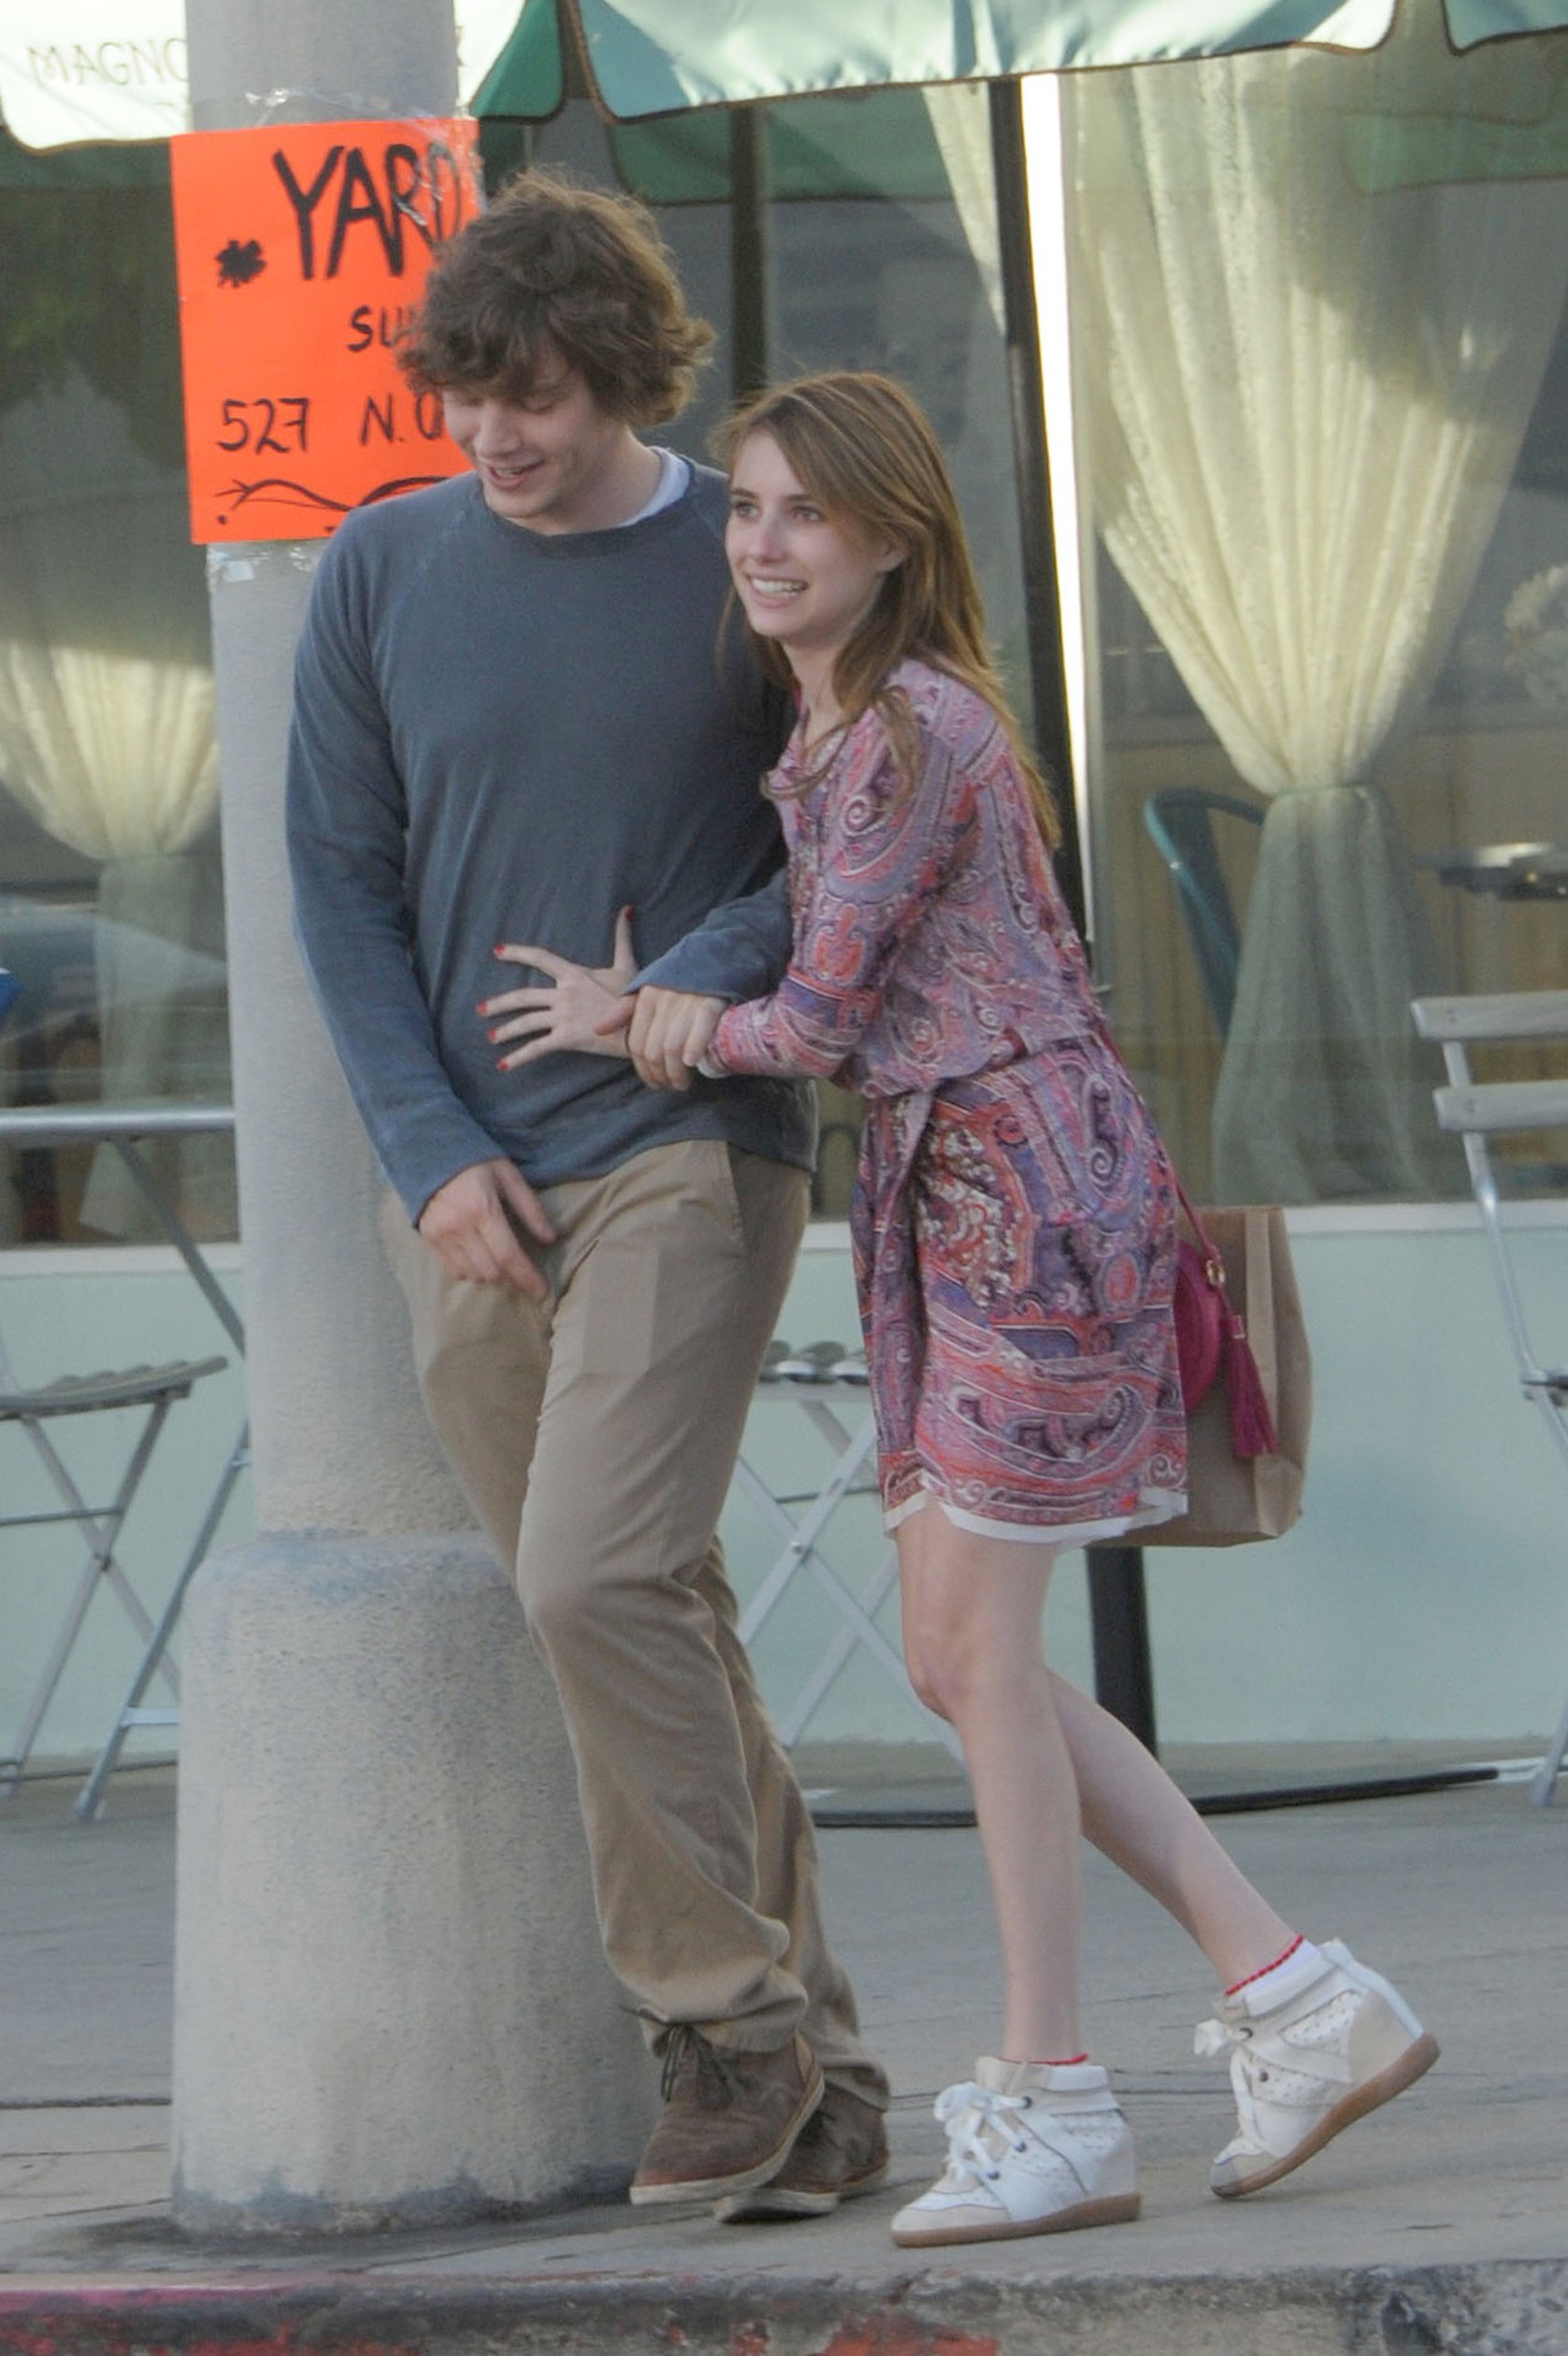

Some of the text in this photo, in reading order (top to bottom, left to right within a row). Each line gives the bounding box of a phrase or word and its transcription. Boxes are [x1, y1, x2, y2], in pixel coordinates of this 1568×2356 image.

[272, 141, 462, 280] YARD
[346, 305, 415, 352] SU
[216, 396, 310, 454] 527
